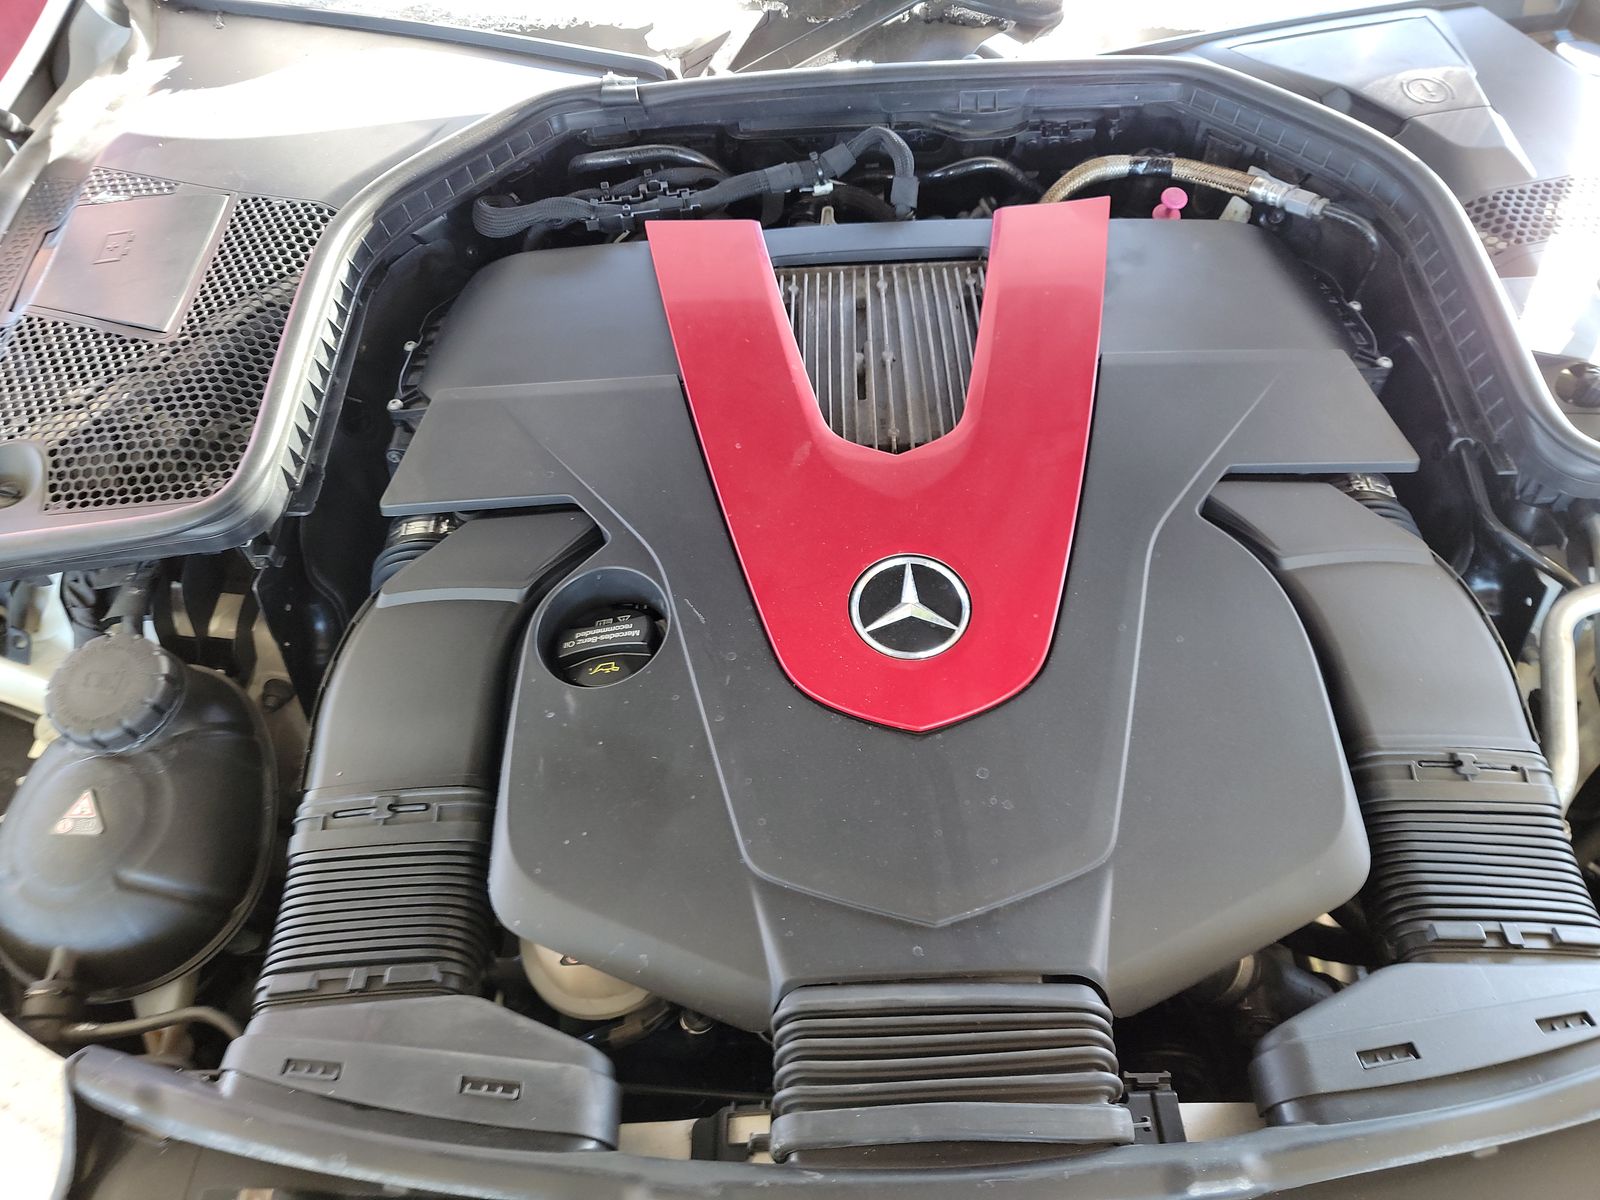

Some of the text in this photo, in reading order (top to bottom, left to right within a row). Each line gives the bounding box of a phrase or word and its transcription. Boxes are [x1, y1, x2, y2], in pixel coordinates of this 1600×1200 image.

[563, 629, 641, 649] Mercedes-Benz Oil
[575, 623, 633, 639] recommended
